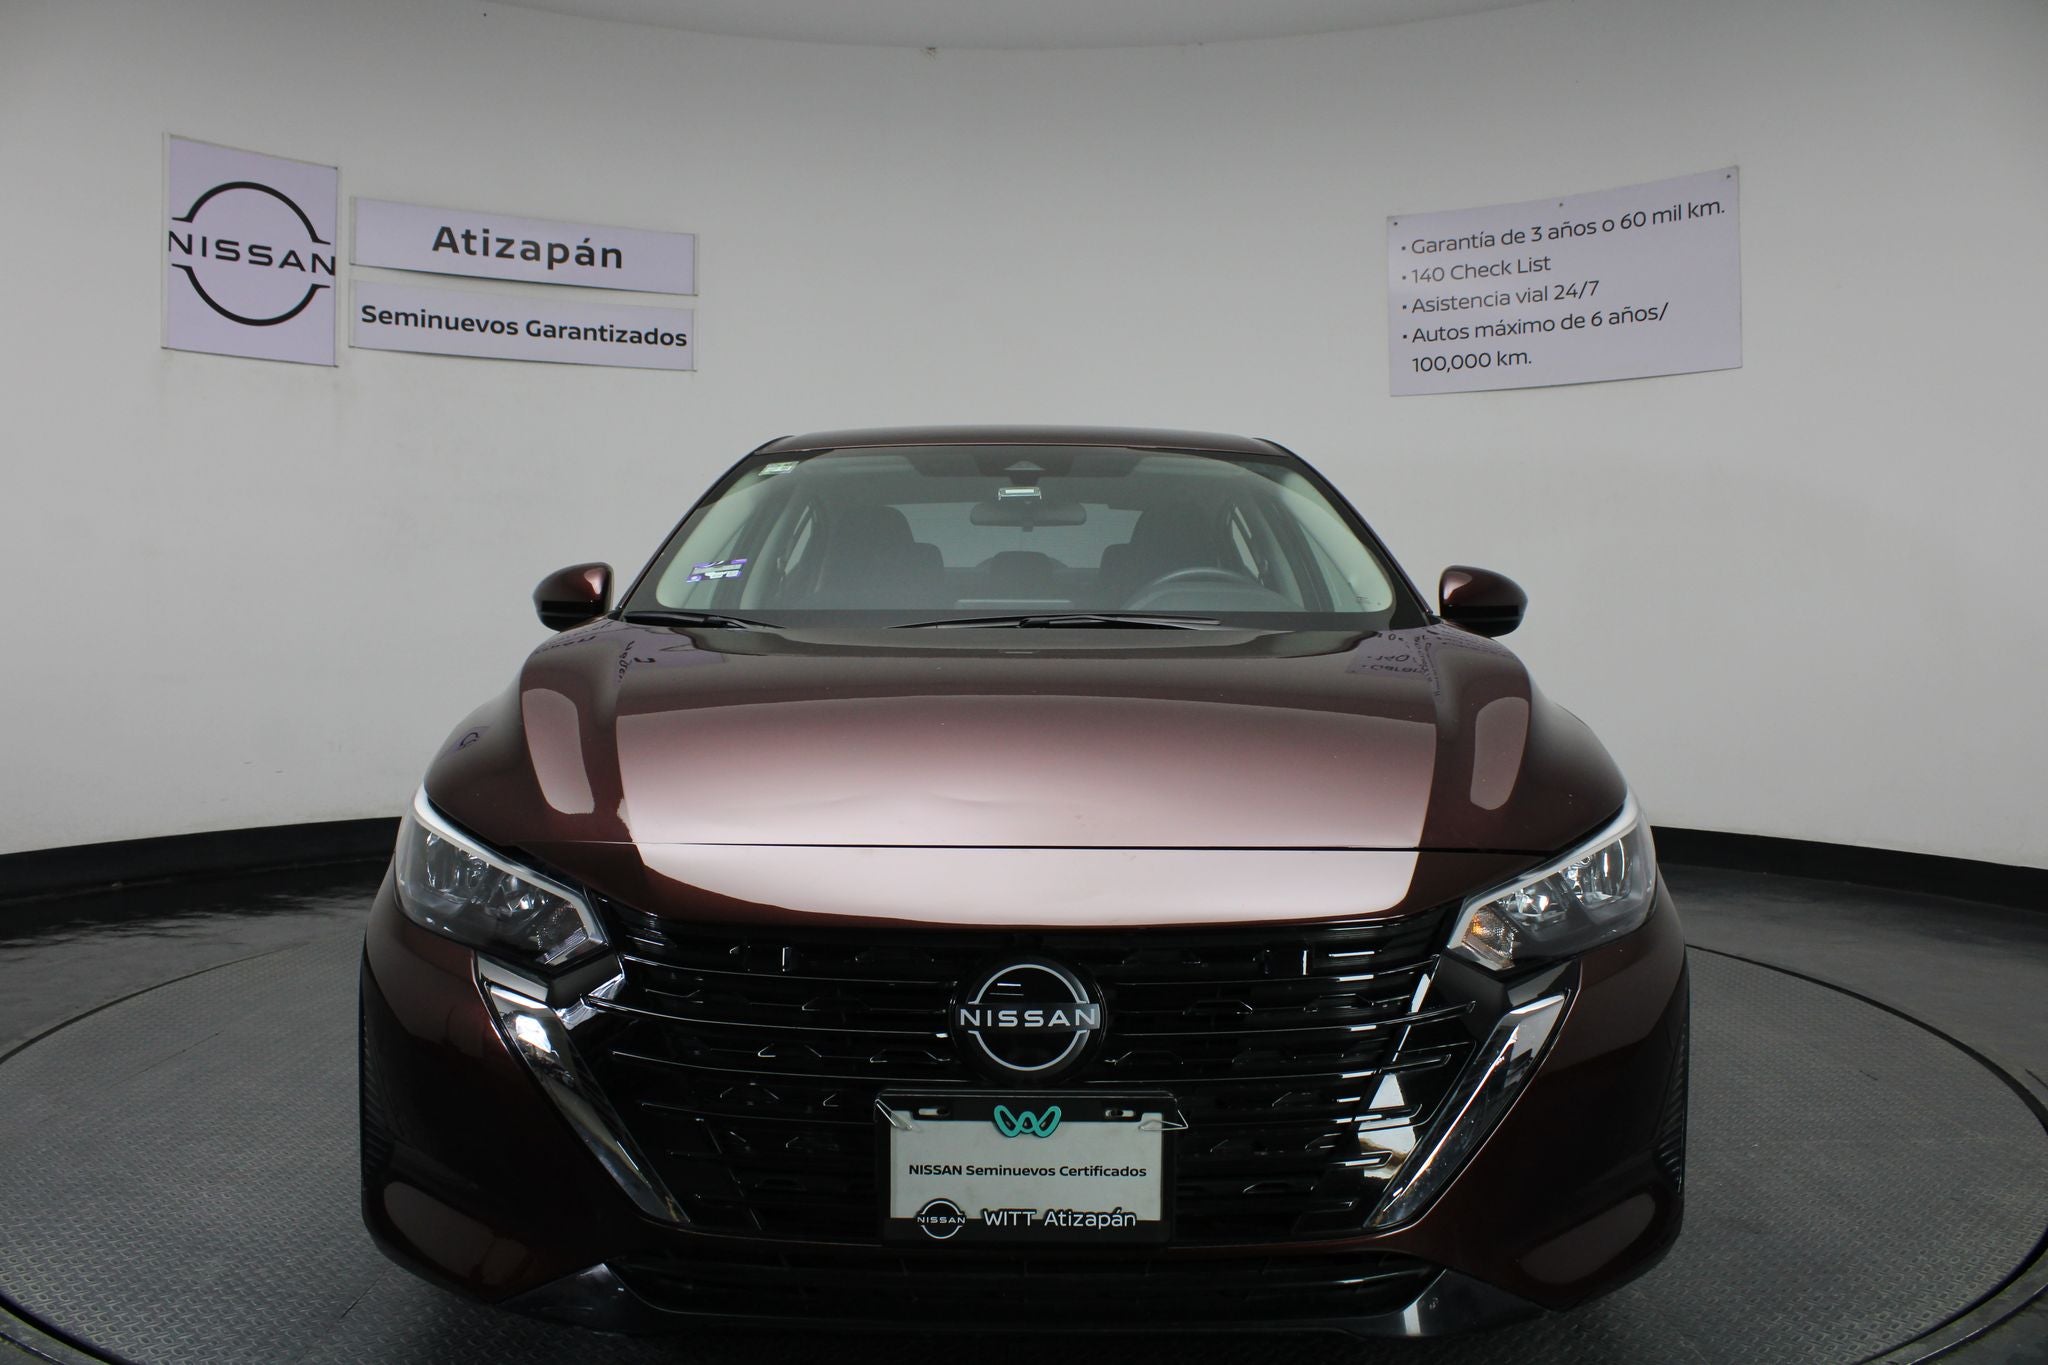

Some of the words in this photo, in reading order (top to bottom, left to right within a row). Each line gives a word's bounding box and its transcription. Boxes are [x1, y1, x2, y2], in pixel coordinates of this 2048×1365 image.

[1411, 231, 1495, 254] Garantía
[1500, 229, 1526, 247] de
[1530, 226, 1543, 243] 3
[1547, 221, 1597, 241] años
[1601, 219, 1615, 233] o
[1620, 211, 1647, 231] 60
[1652, 204, 1682, 226] mil
[1687, 199, 1725, 219] km.
[168, 231, 336, 276] NISSAN
[432, 226, 624, 270] Atizapán
[1411, 266, 1445, 283] 140
[1450, 260, 1512, 281] Check
[1517, 255, 1552, 273] List
[1411, 291, 1511, 313] Asistencia
[1516, 286, 1548, 305] vial
[1553, 280, 1600, 301] 24/7
[361, 304, 519, 337] Seminuevos
[525, 320, 688, 347] Garantizados
[1411, 324, 1469, 343] Autos
[1475, 318, 1556, 339] máximo
[1560, 313, 1586, 331] de
[1591, 309, 1603, 327] 6
[1608, 302, 1669, 325] años/
[1411, 352, 1492, 374] 100,000
[1496, 351, 1532, 367] km.
[960, 1008, 1097, 1027] NISSAN
[908, 1165, 963, 1177] NISSAN
[965, 1165, 1056, 1178] Seminuevos
[1059, 1165, 1147, 1178] Certificados
[917, 1216, 966, 1225] NISSAN
[985, 1210, 1036, 1226] WITT
[1044, 1208, 1136, 1229] Atizapán
